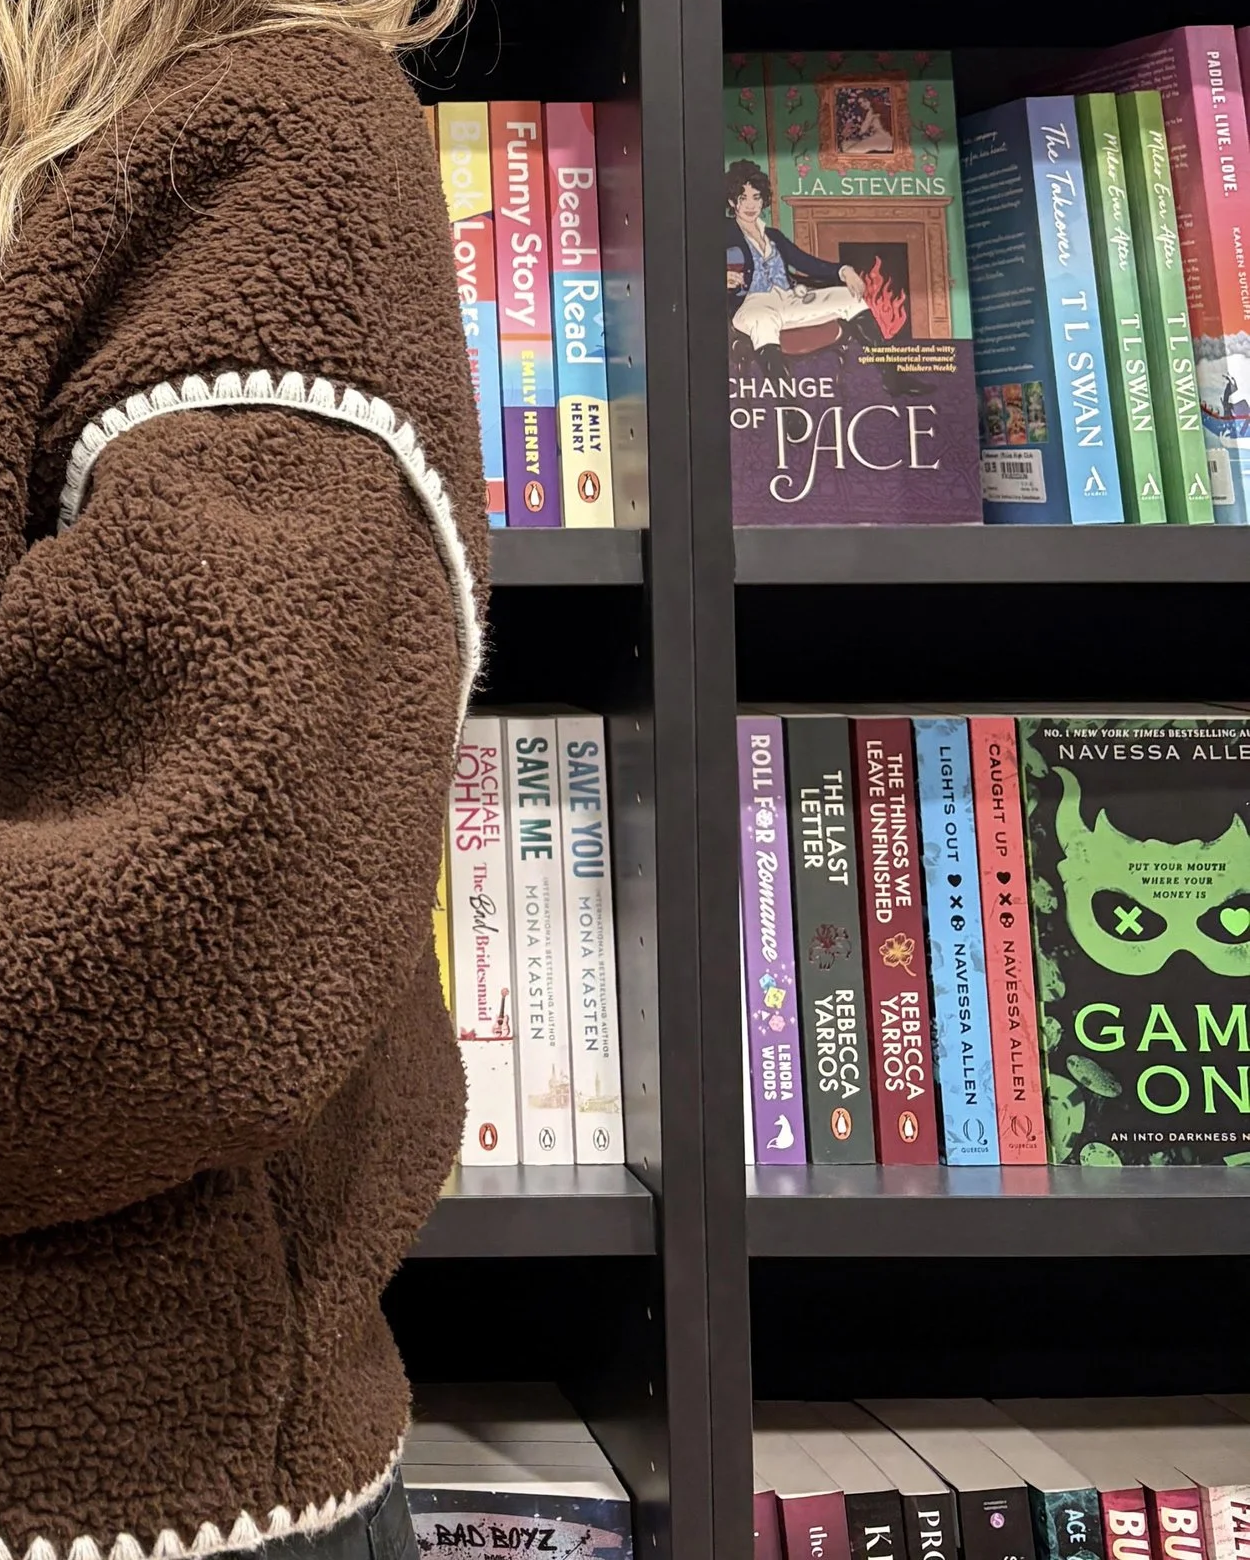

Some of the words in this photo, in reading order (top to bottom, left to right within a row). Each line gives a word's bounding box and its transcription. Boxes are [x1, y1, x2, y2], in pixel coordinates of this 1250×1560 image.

[1207, 51, 1226, 110] PADDLE.
[1043, 124, 1071, 164] The
[1215, 115, 1231, 152] LIVE.
[500, 121, 537, 225] Funny
[792, 178, 834, 196] J.A.
[841, 178, 945, 195] STEVENS
[1220, 156, 1238, 197] LOVE.
[557, 167, 597, 265] Beach
[1047, 171, 1074, 267] Takeover
[505, 234, 542, 327] Story
[562, 280, 603, 365] Read
[521, 350, 537, 405] EMILY
[522, 410, 539, 475] HENRY
[572, 403, 584, 454] HENRY
[588, 404, 601, 451] EMILY
[730, 409, 765, 430] OF
[770, 404, 940, 503] PACE
[1044, 729, 1062, 737] NO.
[1066, 729, 1069, 737] 1
[1074, 729, 1098, 737] NEW
[1102, 729, 1129, 737] YORK
[1133, 729, 1165, 737] TIMES
[1169, 729, 1236, 738] BESTSELLING
[1059, 744, 1180, 760] NAVESSA
[516, 738, 551, 808] SAVE
[822, 771, 844, 816] THE
[940, 747, 956, 815] LIGHTS
[520, 819, 552, 861] ME
[801, 788, 823, 869] LETTER
[944, 822, 959, 862] OUT
[825, 825, 848, 886] LAST
[1129, 863, 1149, 871] PUT
[1153, 863, 1183, 871] YOUR
[1187, 863, 1226, 871] MOUTH
[1184, 877, 1213, 885] YOUR
[1153, 891, 1191, 899] MONEY
[1197, 891, 1206, 899] IS
[955, 944, 972, 1033] NAVESSA
[813, 995, 838, 1092] YARROS
[835, 990, 860, 1098] REBECCA
[961, 1041, 977, 1105] ALLEN
[1137, 1064, 1250, 1114] ON
[1111, 1133, 1127, 1141] AN
[1134, 1133, 1163, 1141] INTO
[1169, 1133, 1237, 1141] DARKNESS
[435, 1523, 485, 1547] BAD
[489, 1526, 557, 1551] BOYZ
